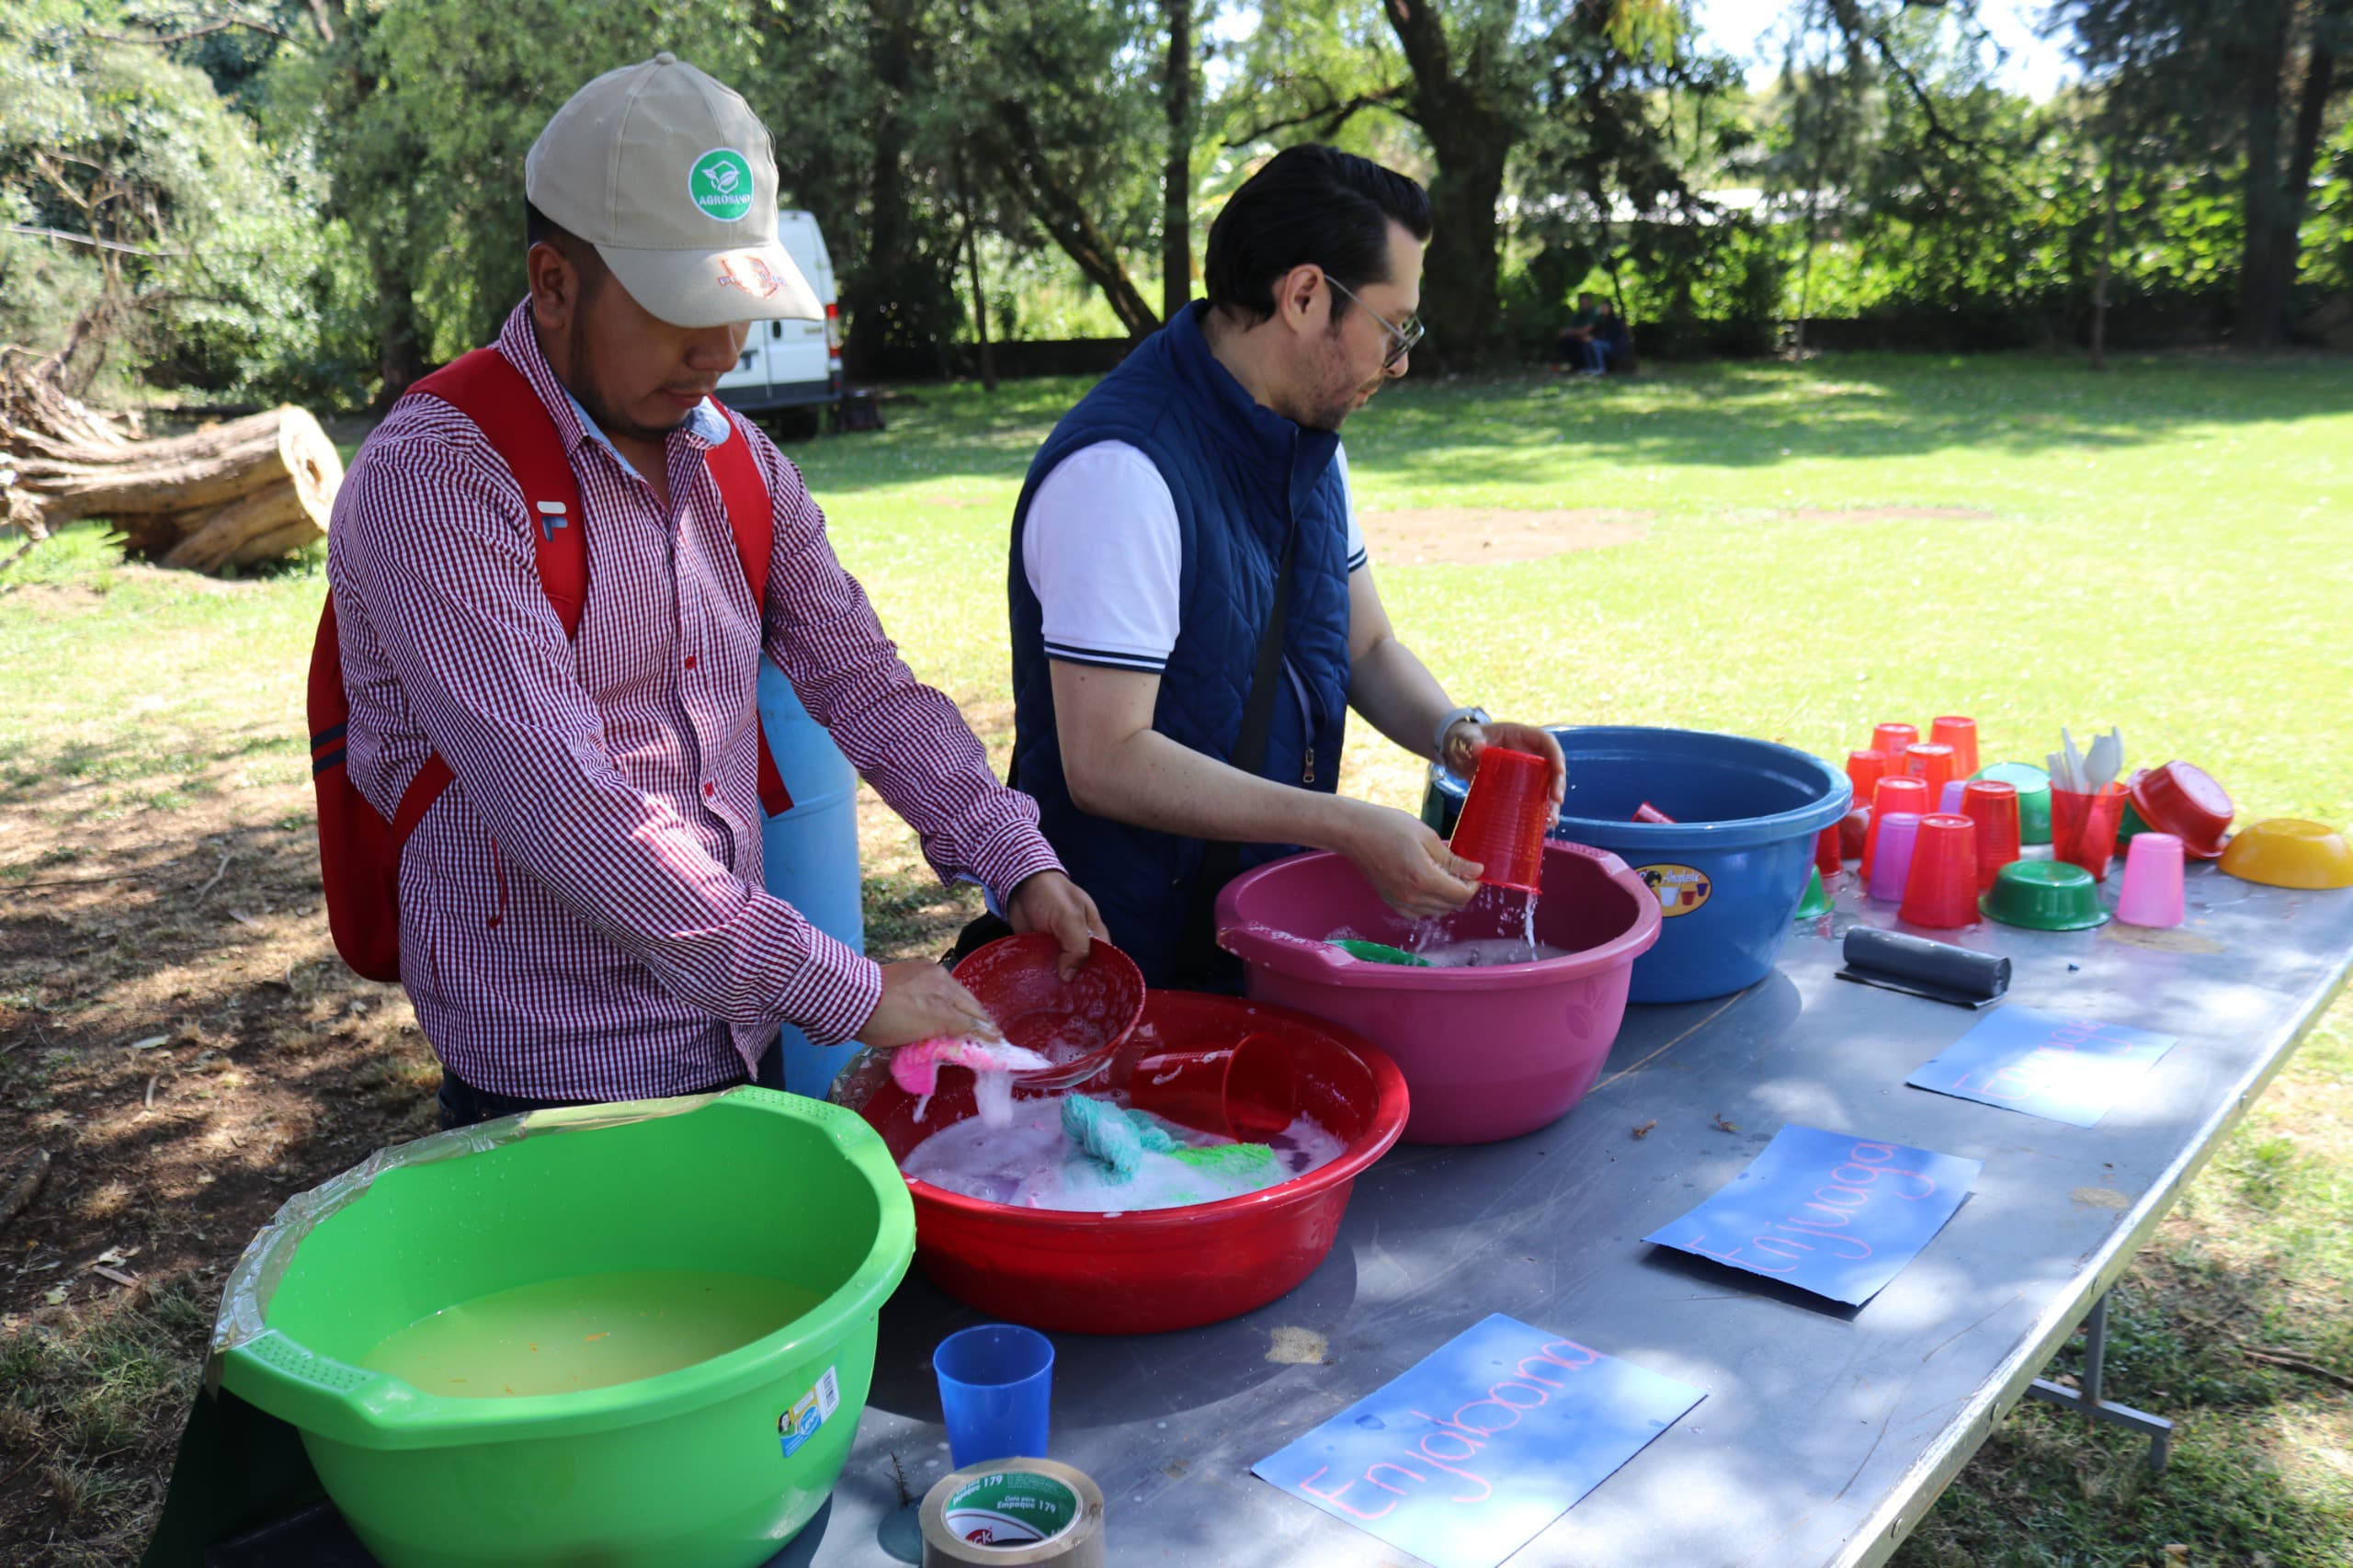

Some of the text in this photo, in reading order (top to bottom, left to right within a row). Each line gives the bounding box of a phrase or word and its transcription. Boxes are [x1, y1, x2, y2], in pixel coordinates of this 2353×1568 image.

[1300, 1339, 1607, 1521] Enjabona
[984, 1475, 1003, 1487] 179
[996, 1500, 1056, 1514] Empaque 179
